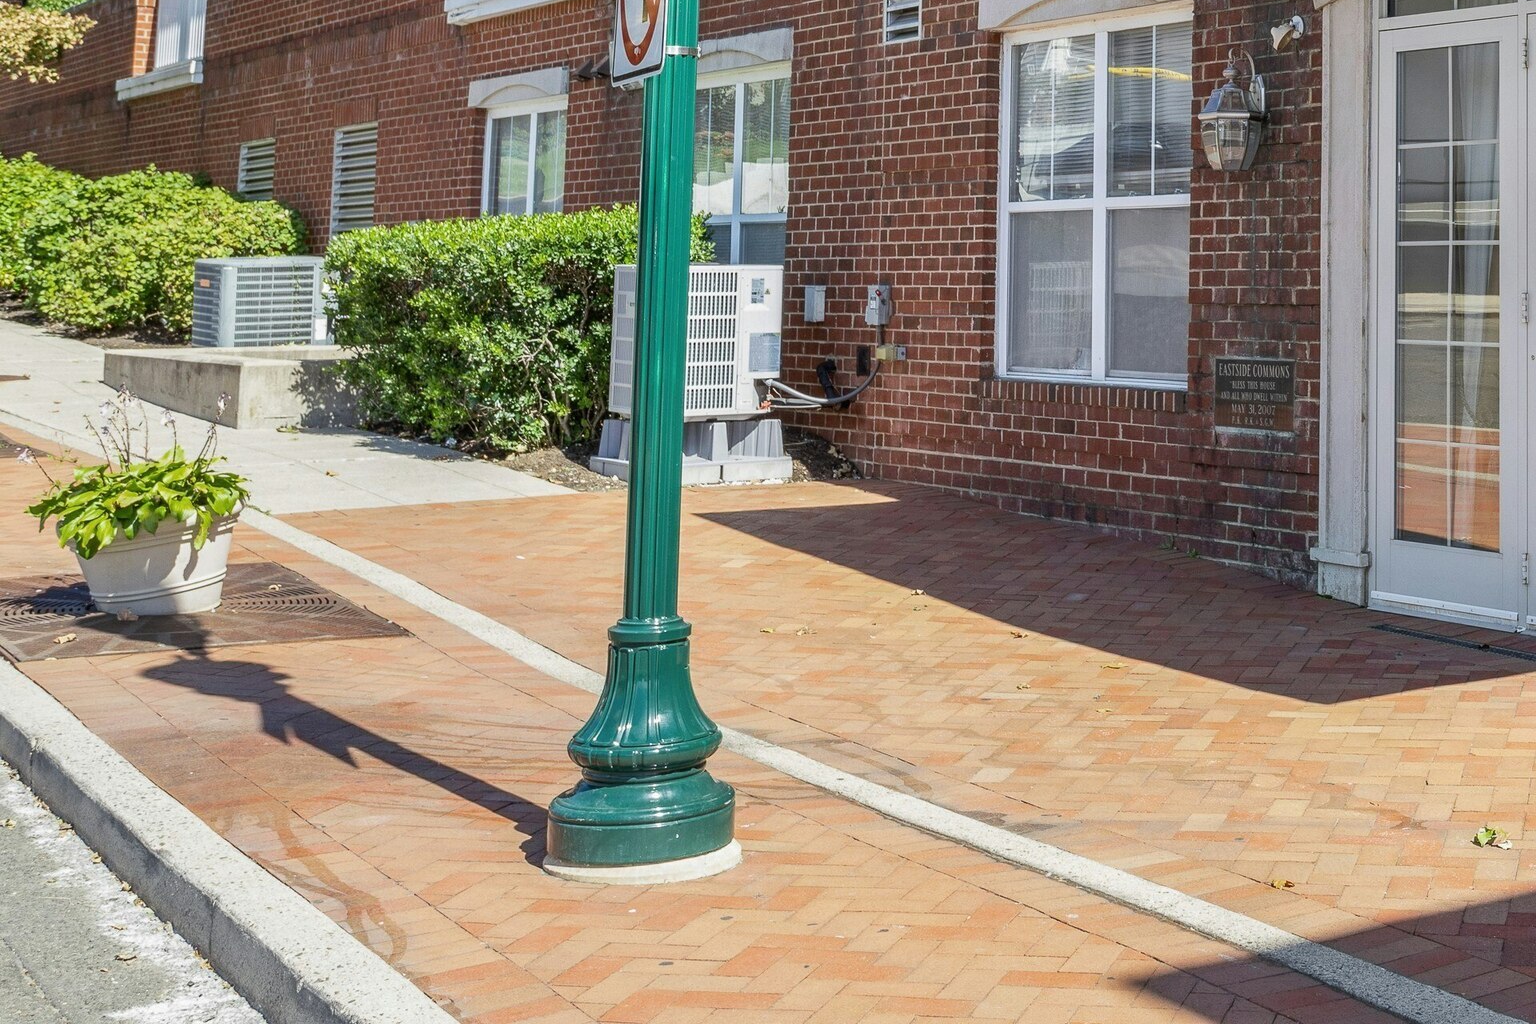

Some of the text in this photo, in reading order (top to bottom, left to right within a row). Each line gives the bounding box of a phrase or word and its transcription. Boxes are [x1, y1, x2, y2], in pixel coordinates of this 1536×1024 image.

[1218, 363, 1290, 378] EASTSIDE COMMONS
[1247, 381, 1258, 390] THIS
[1260, 382, 1276, 391] HOUSE
[1220, 391, 1230, 400] AND
[1231, 392, 1240, 400] ALL
[1241, 392, 1252, 401] WHO
[1253, 392, 1268, 402] DWELL
[1231, 403, 1276, 416] MAY 31, 2007
